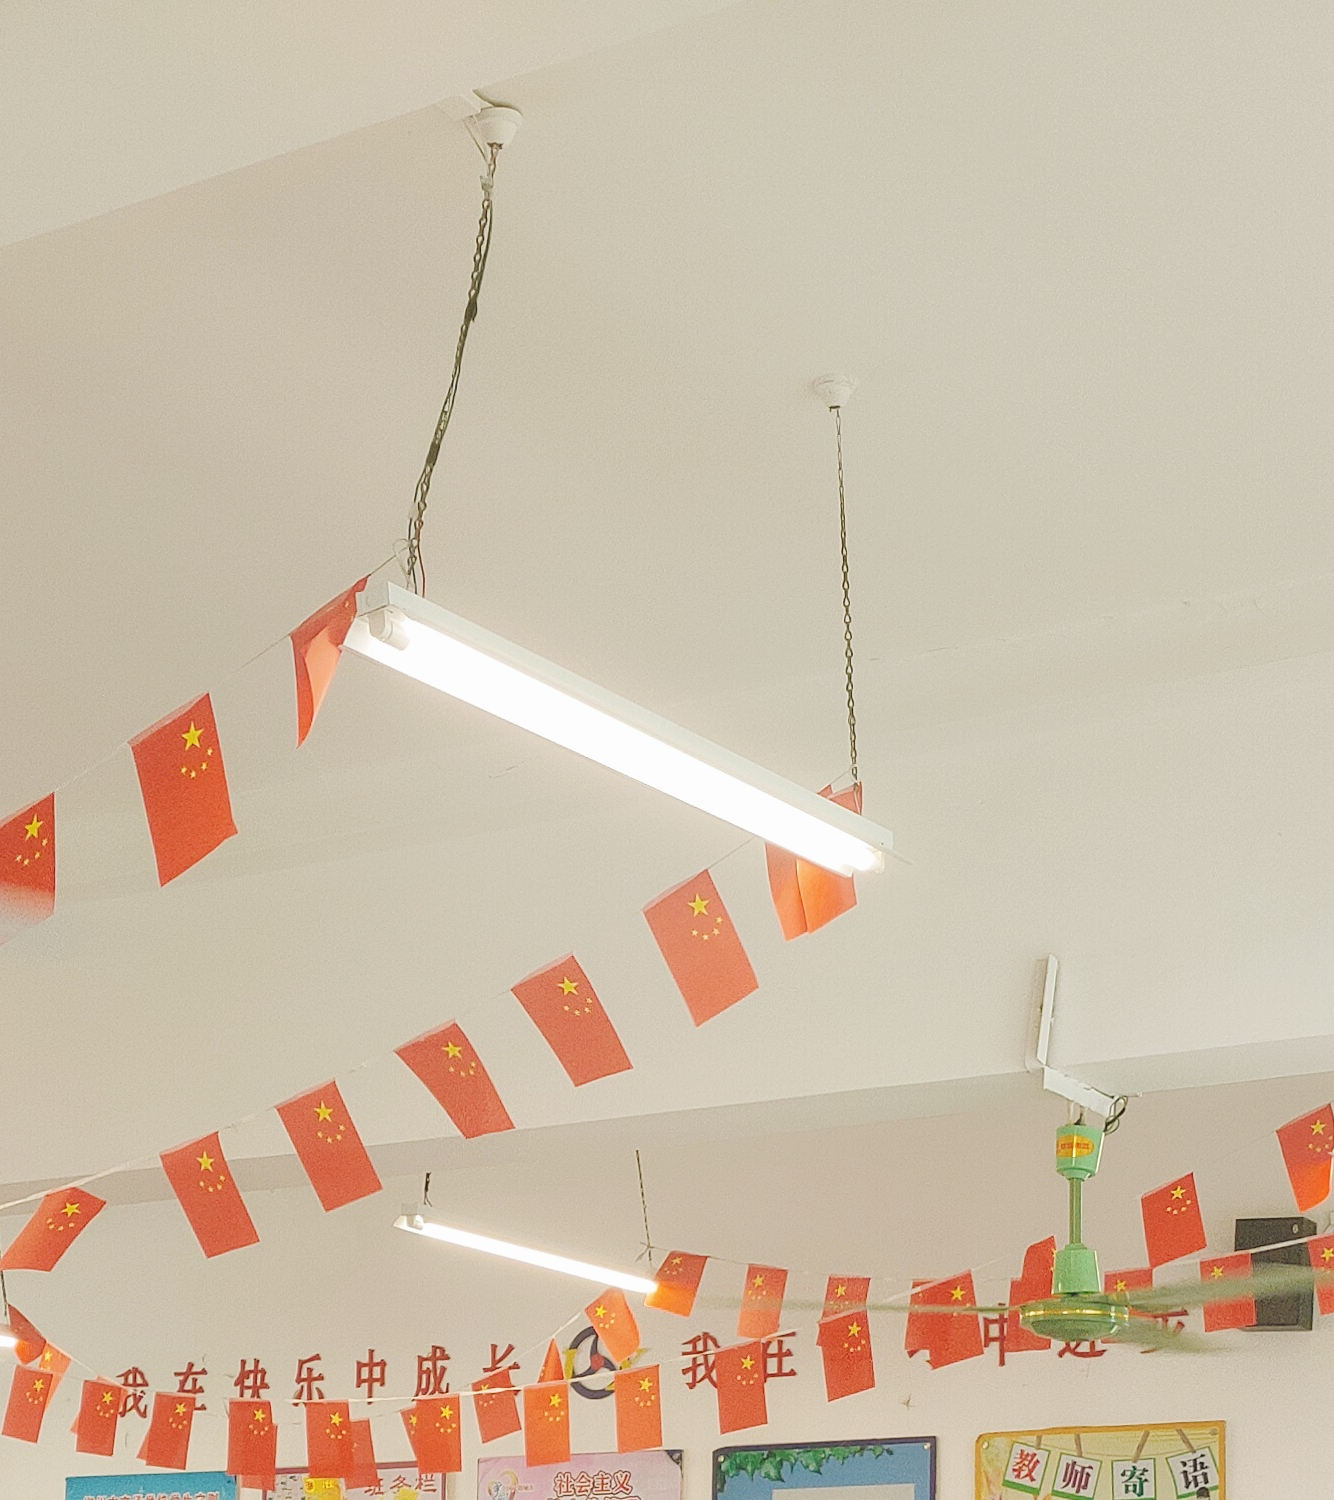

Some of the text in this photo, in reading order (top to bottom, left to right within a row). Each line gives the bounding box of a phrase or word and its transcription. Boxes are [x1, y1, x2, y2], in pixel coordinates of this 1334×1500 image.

[554, 1470, 633, 1497] 社会主义
[1012, 1449, 1210, 1498] 教师寄语
